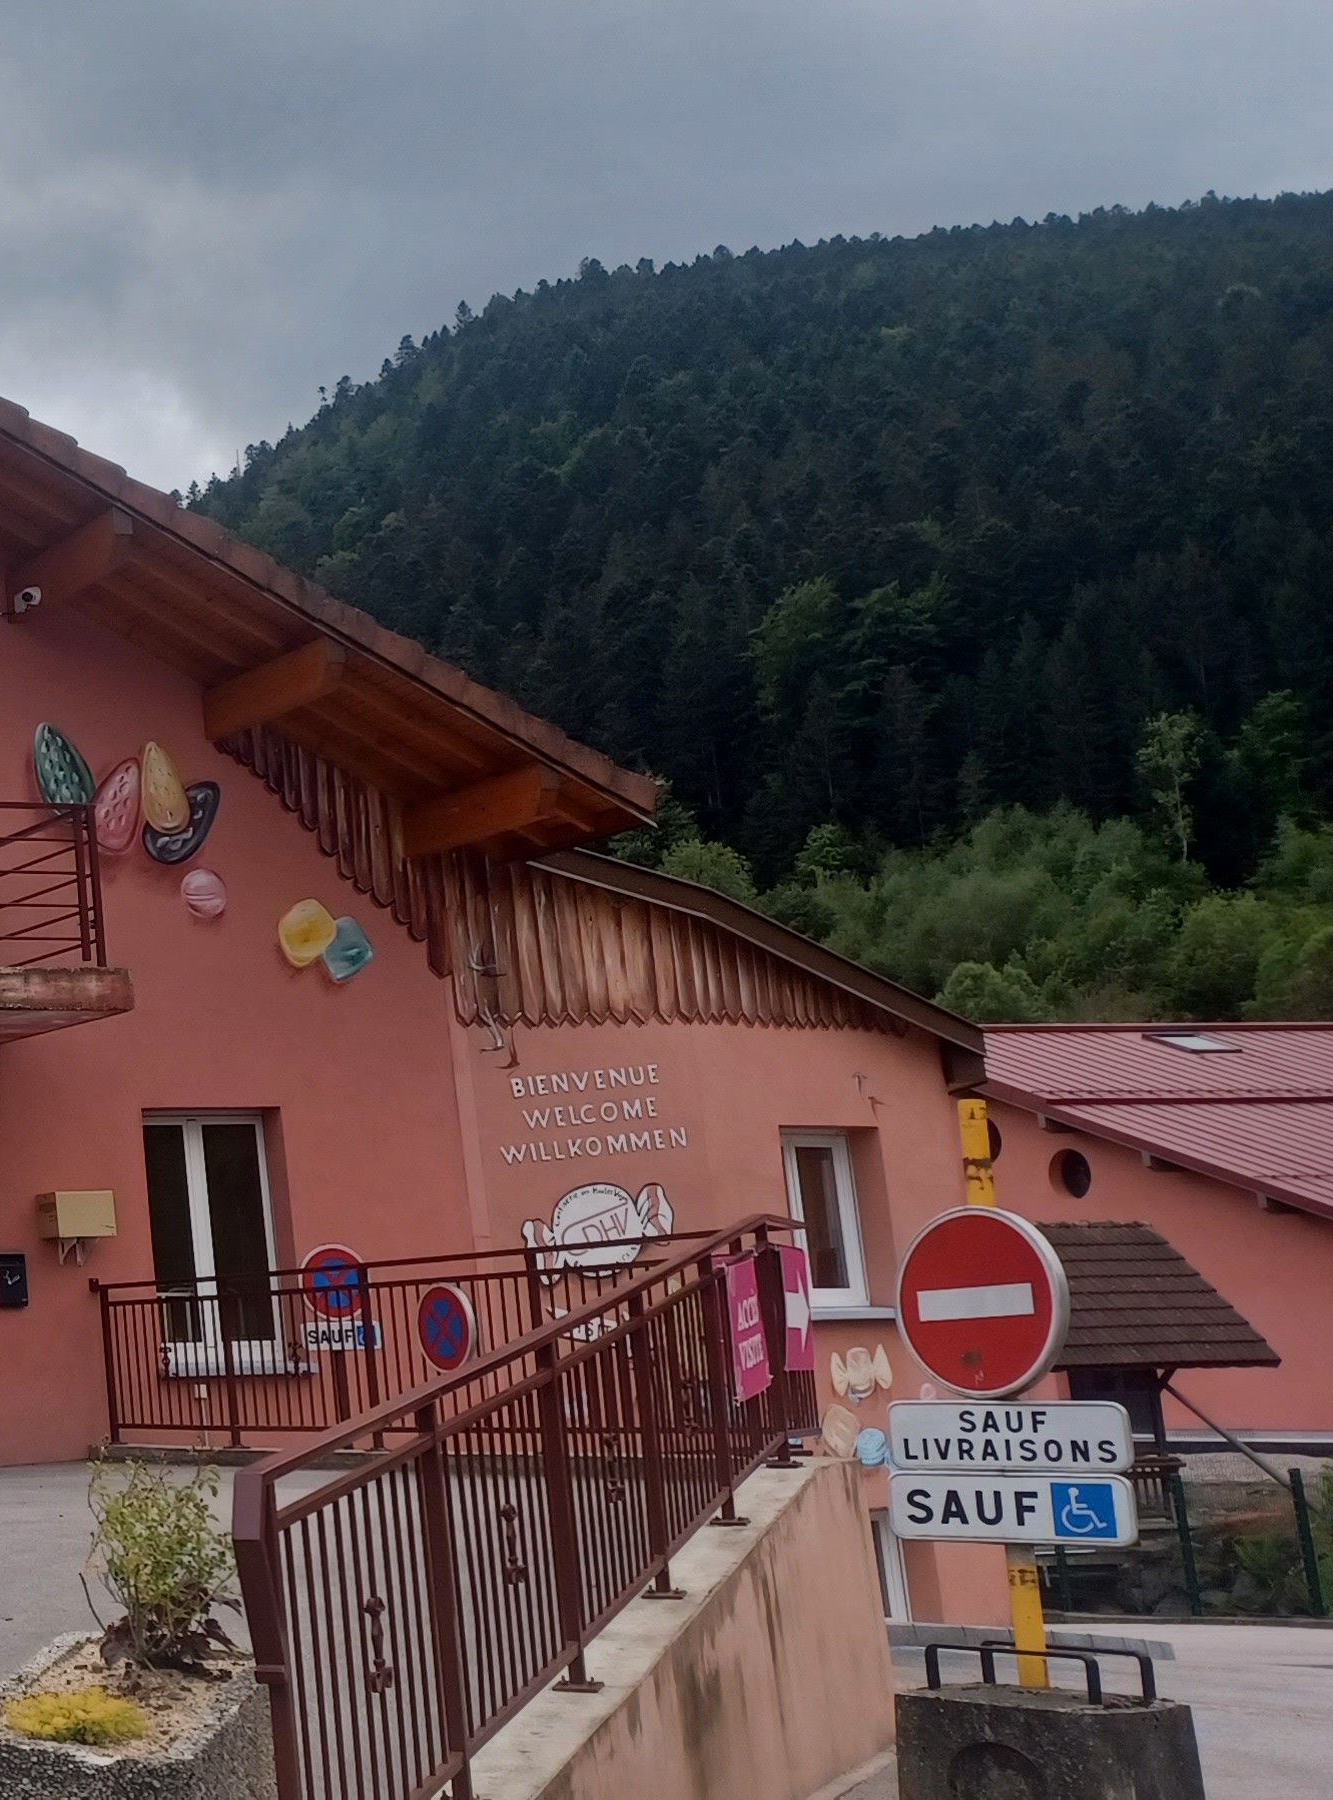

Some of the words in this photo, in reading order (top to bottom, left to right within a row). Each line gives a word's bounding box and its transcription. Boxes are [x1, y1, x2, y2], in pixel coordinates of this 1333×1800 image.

[510, 1063, 661, 1098] BIENVENUE
[522, 1097, 659, 1130] WELCOME
[500, 1127, 690, 1166] WILLKOMMEN
[561, 1198, 628, 1256] CDHV
[307, 1329, 354, 1345] SAUF
[958, 1410, 1047, 1433] SAUF
[903, 1438, 1118, 1463] LIVRAISONS
[906, 1489, 1039, 1526] SAUF
